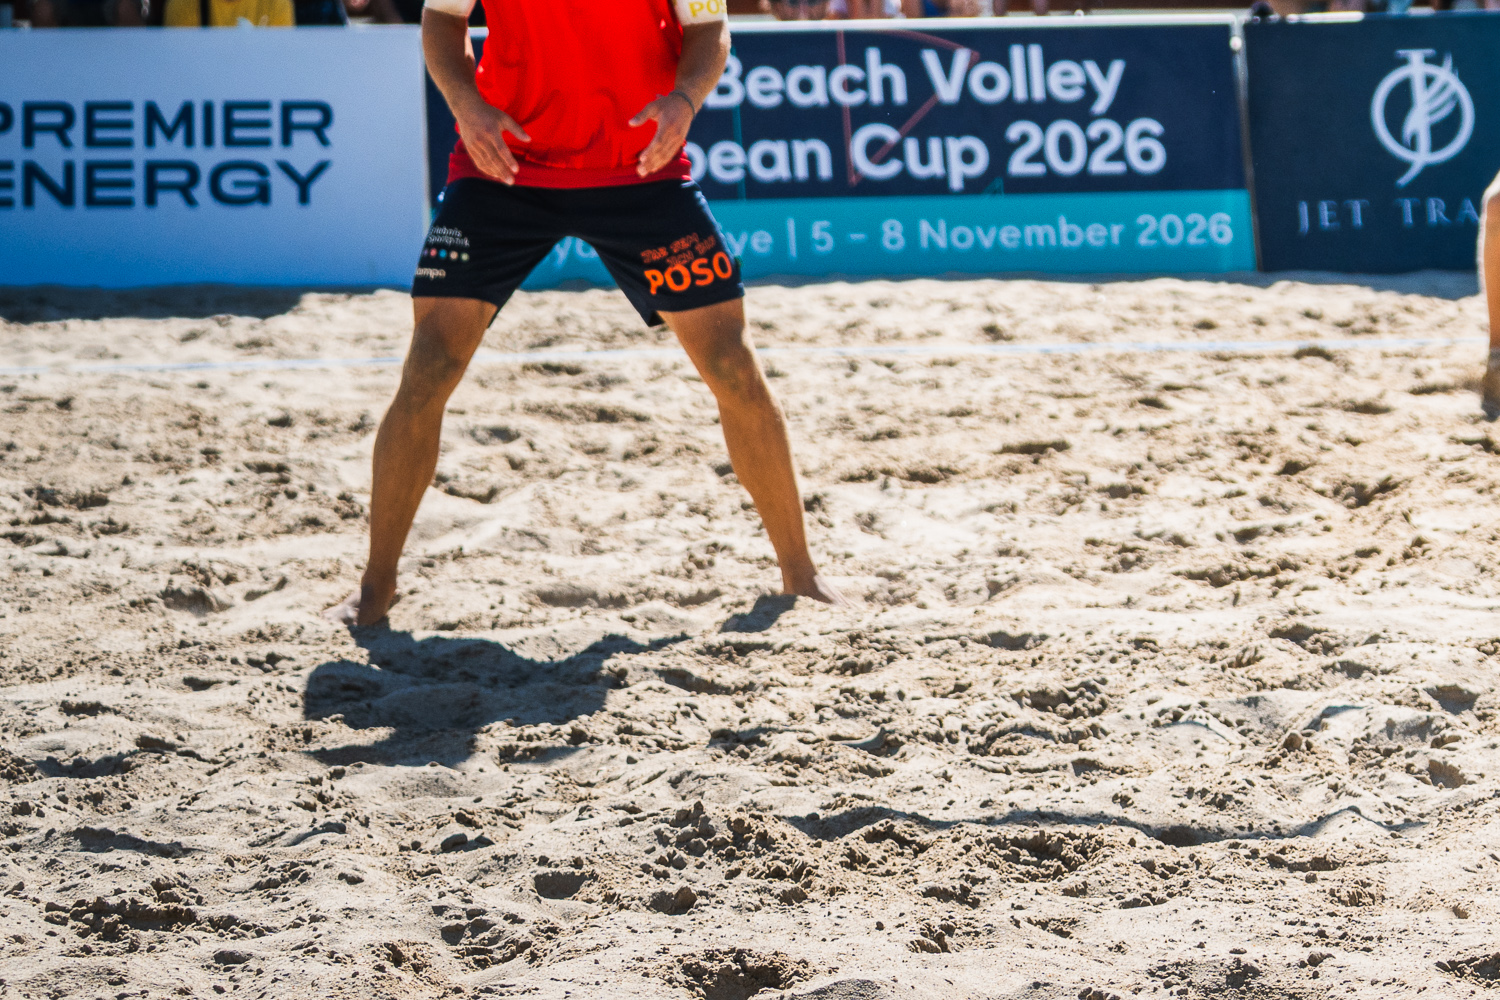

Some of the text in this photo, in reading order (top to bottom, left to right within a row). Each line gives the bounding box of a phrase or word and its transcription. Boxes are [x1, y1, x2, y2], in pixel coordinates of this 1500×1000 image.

[704, 45, 1126, 116] Beach Volley
[0, 101, 334, 148] REMIER
[851, 121, 990, 191] Cup
[1005, 117, 1167, 176] 2026
[0, 160, 333, 209] NERGY
[810, 220, 834, 251] 5
[880, 219, 906, 250] 8
[919, 214, 1124, 250] November
[1135, 212, 1234, 248] 2026
[1300, 199, 1370, 235] JET
[643, 251, 732, 295] POSO
